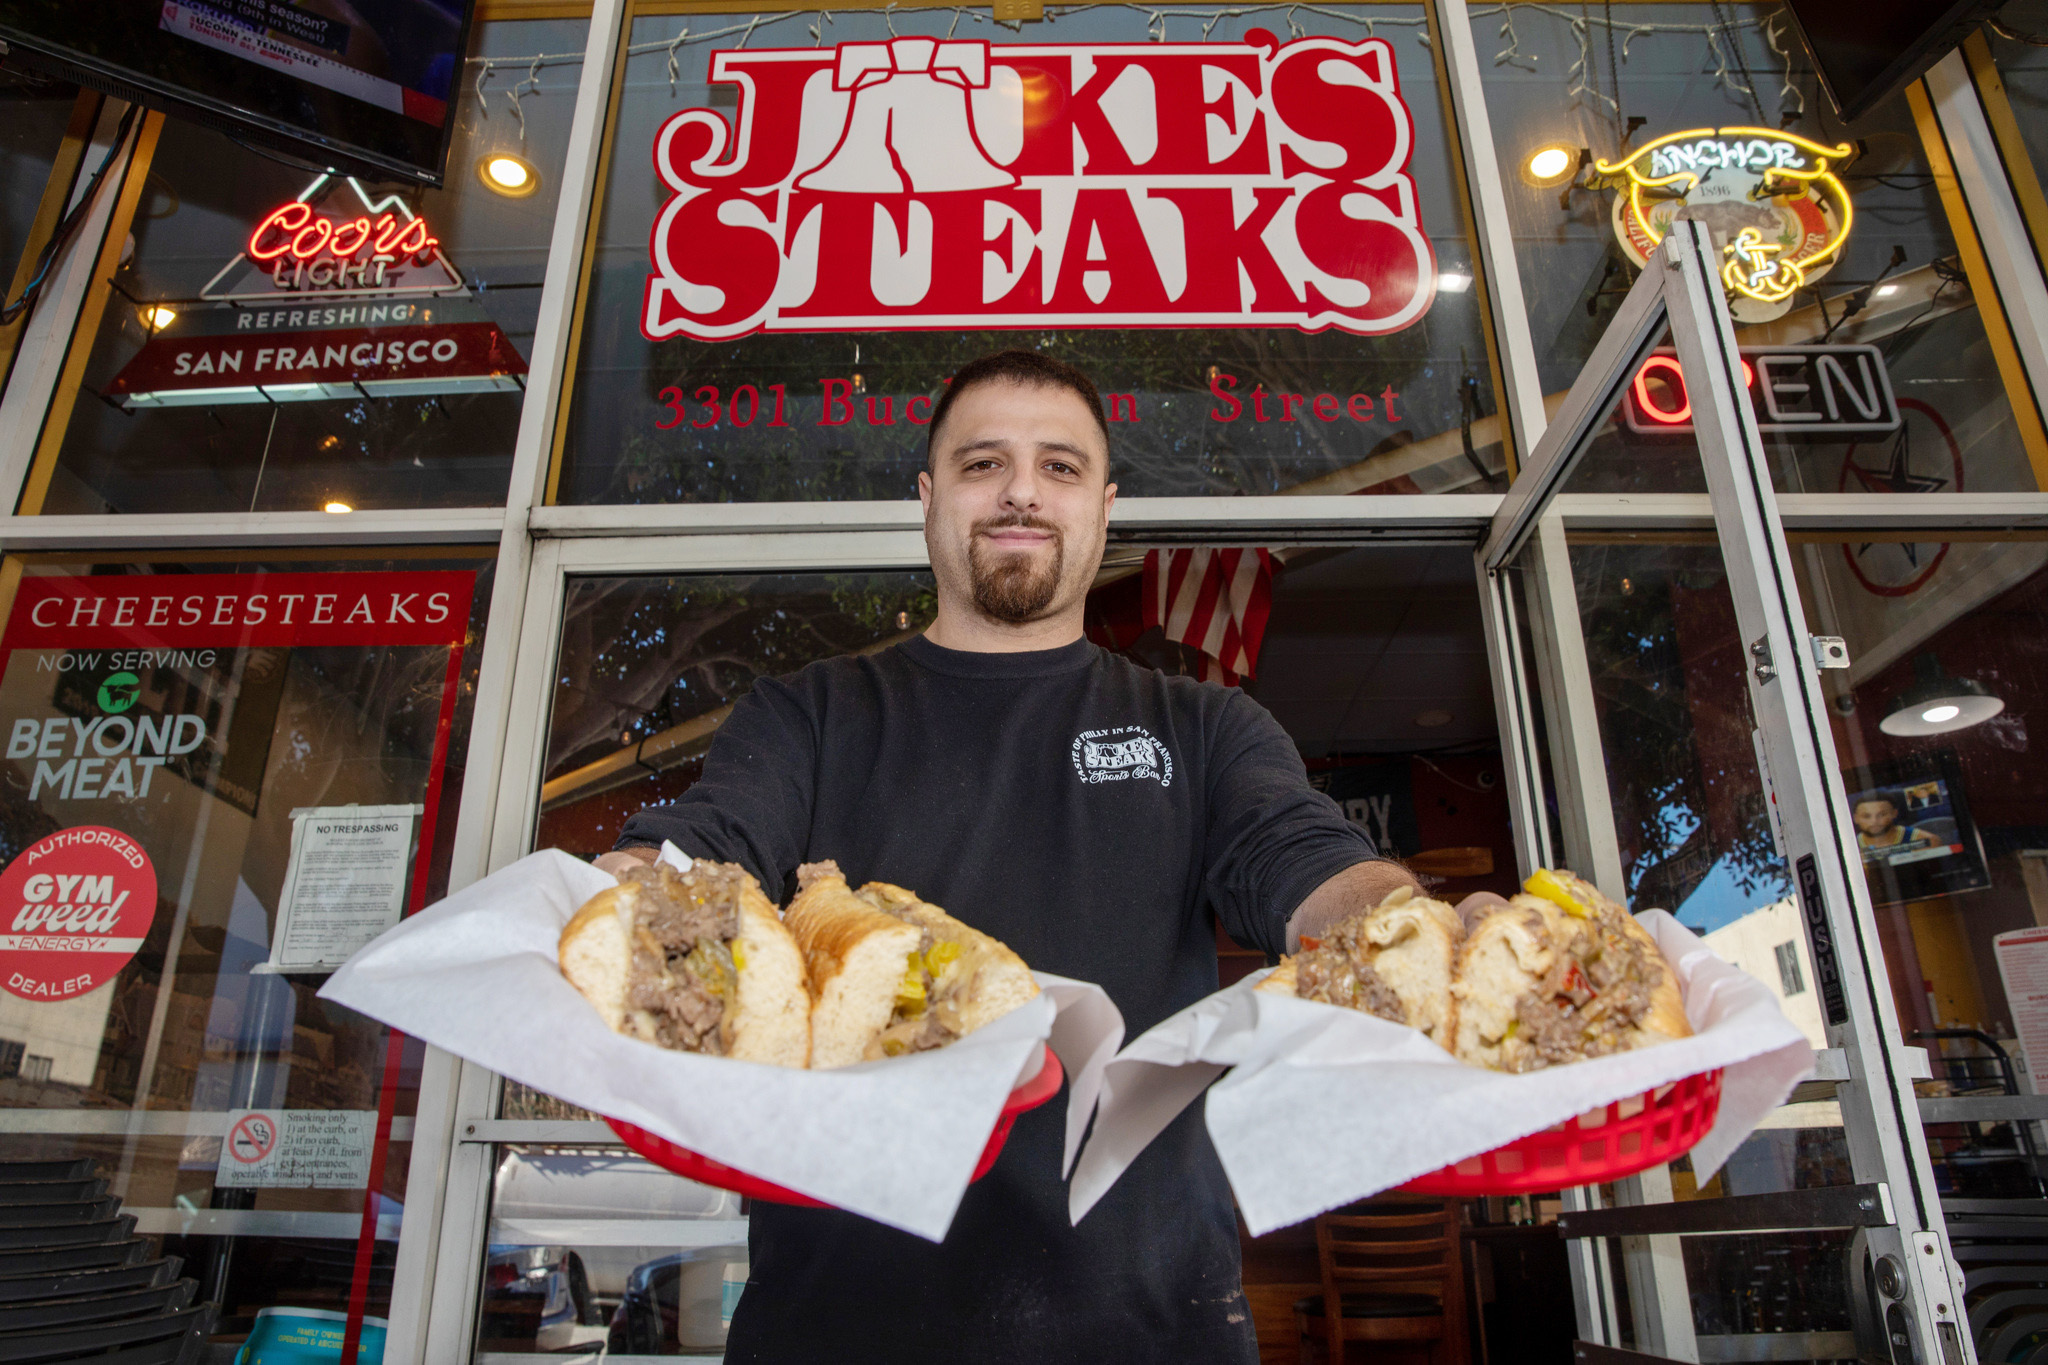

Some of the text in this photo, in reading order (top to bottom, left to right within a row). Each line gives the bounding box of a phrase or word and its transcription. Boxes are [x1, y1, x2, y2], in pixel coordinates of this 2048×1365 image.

[269, 2, 328, 32] season?
[256, 38, 320, 67] TENNESSEE
[1651, 140, 1805, 177] ANCHOR
[250, 202, 438, 260] Coors
[272, 254, 396, 288] LIGHT
[648, 182, 1430, 340] STEAKS
[237, 304, 408, 329] REFRESHING
[173, 338, 458, 376] SAN FRANCISCO
[655, 384, 789, 429] 3301
[1209, 374, 1402, 423] Street
[1634, 354, 1881, 423] OEN
[30, 592, 451, 628] CHEESESTEAKS
[36, 649, 216, 672] NOW SERVING
[5, 714, 206, 760] BEYOND
[1085, 750, 1157, 768] STEAKS
[1112, 727, 1124, 735] IN
[1126, 725, 1149, 737] SAN
[1148, 736, 1173, 787] FRANCISCO
[28, 756, 167, 801] MEAT
[1088, 769, 1130, 784] Sports
[316, 823, 399, 834] NO TRESPASSING
[28, 830, 144, 869] AUTHORIZED
[23, 873, 114, 903] GYM
[11, 890, 130, 933] weed
[1801, 869, 1837, 984] PUSH
[18, 936, 100, 951] ENERGY
[8, 972, 92, 997] DEALER
[287, 1112, 348, 1124] Smoking only
[298, 1125, 306, 1134] at
[308, 1124, 322, 1134] the
[348, 1126, 358, 1134] or
[282, 1148, 290, 1156] at
[292, 1147, 313, 1156] least
[315, 1147, 326, 1156] 15
[341, 1147, 362, 1157] from
[295, 1134, 304, 1144] if
[305, 1136, 317, 1144] no
[231, 1168, 269, 1180] operable
[316, 1168, 332, 1179] and
[334, 1170, 358, 1179] vents
